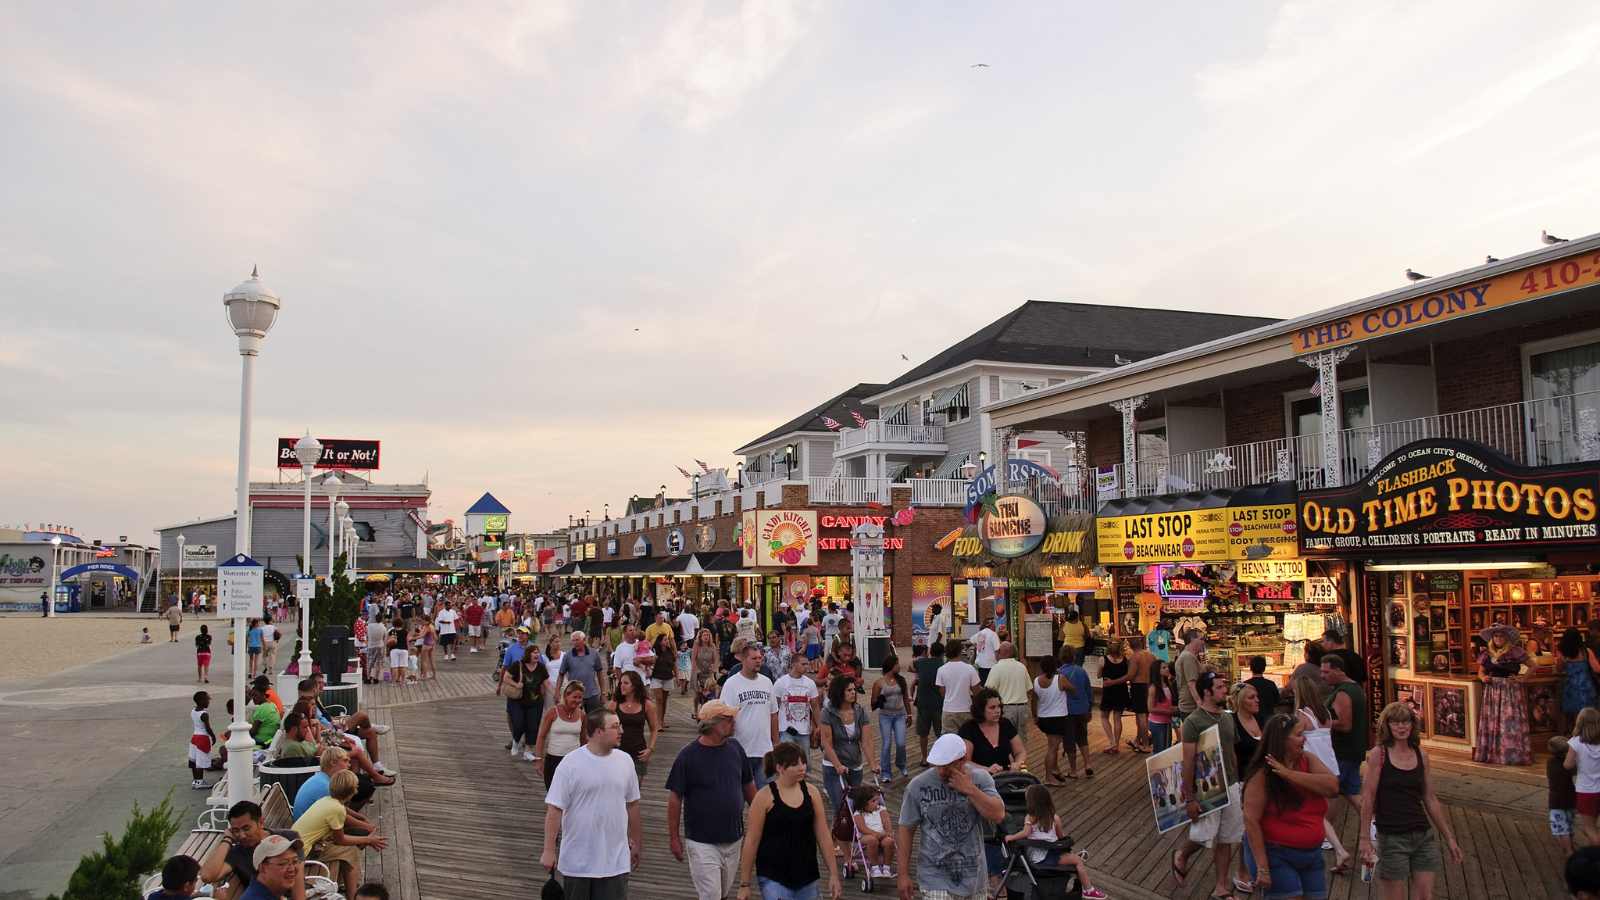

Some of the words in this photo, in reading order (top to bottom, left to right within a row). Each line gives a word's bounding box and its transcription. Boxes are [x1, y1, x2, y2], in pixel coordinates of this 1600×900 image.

[1299, 319, 1353, 350] THE
[1362, 283, 1492, 334] COLONY
[323, 448, 334, 459] It
[337, 452, 350, 460] or
[351, 449, 376, 461] Not!
[1367, 460, 1396, 487] WELCOME
[1397, 454, 1407, 463] TO
[1408, 447, 1431, 459] OCEAN
[1456, 451, 1488, 473] ORIGINAL
[1377, 458, 1457, 496] FLASHBACK
[1233, 510, 1258, 521] LAST
[1262, 508, 1291, 520] STOP
[1303, 501, 1356, 535] OLD
[1361, 486, 1438, 532] TIME
[1447, 477, 1597, 521] PHOTOS
[762, 514, 782, 540] CANDY
[783, 511, 812, 540] KITCHEN
[1125, 517, 1153, 539] LAST
[1158, 514, 1192, 538] STOP
[1244, 523, 1281, 531] BEACHWEAR
[1423, 530, 1476, 544] PORTRAITS
[1484, 528, 1520, 541] READY
[1525, 527, 1538, 539] IN
[1542, 524, 1597, 539] MINUTES
[1042, 530, 1088, 553] DRINK
[1136, 543, 1181, 557] BEACHWEAR
[1183, 544, 1193, 552] STOP
[1230, 537, 1253, 545] BODY
[1242, 563, 1270, 574] HENNA
[1274, 561, 1303, 574] TATTOO
